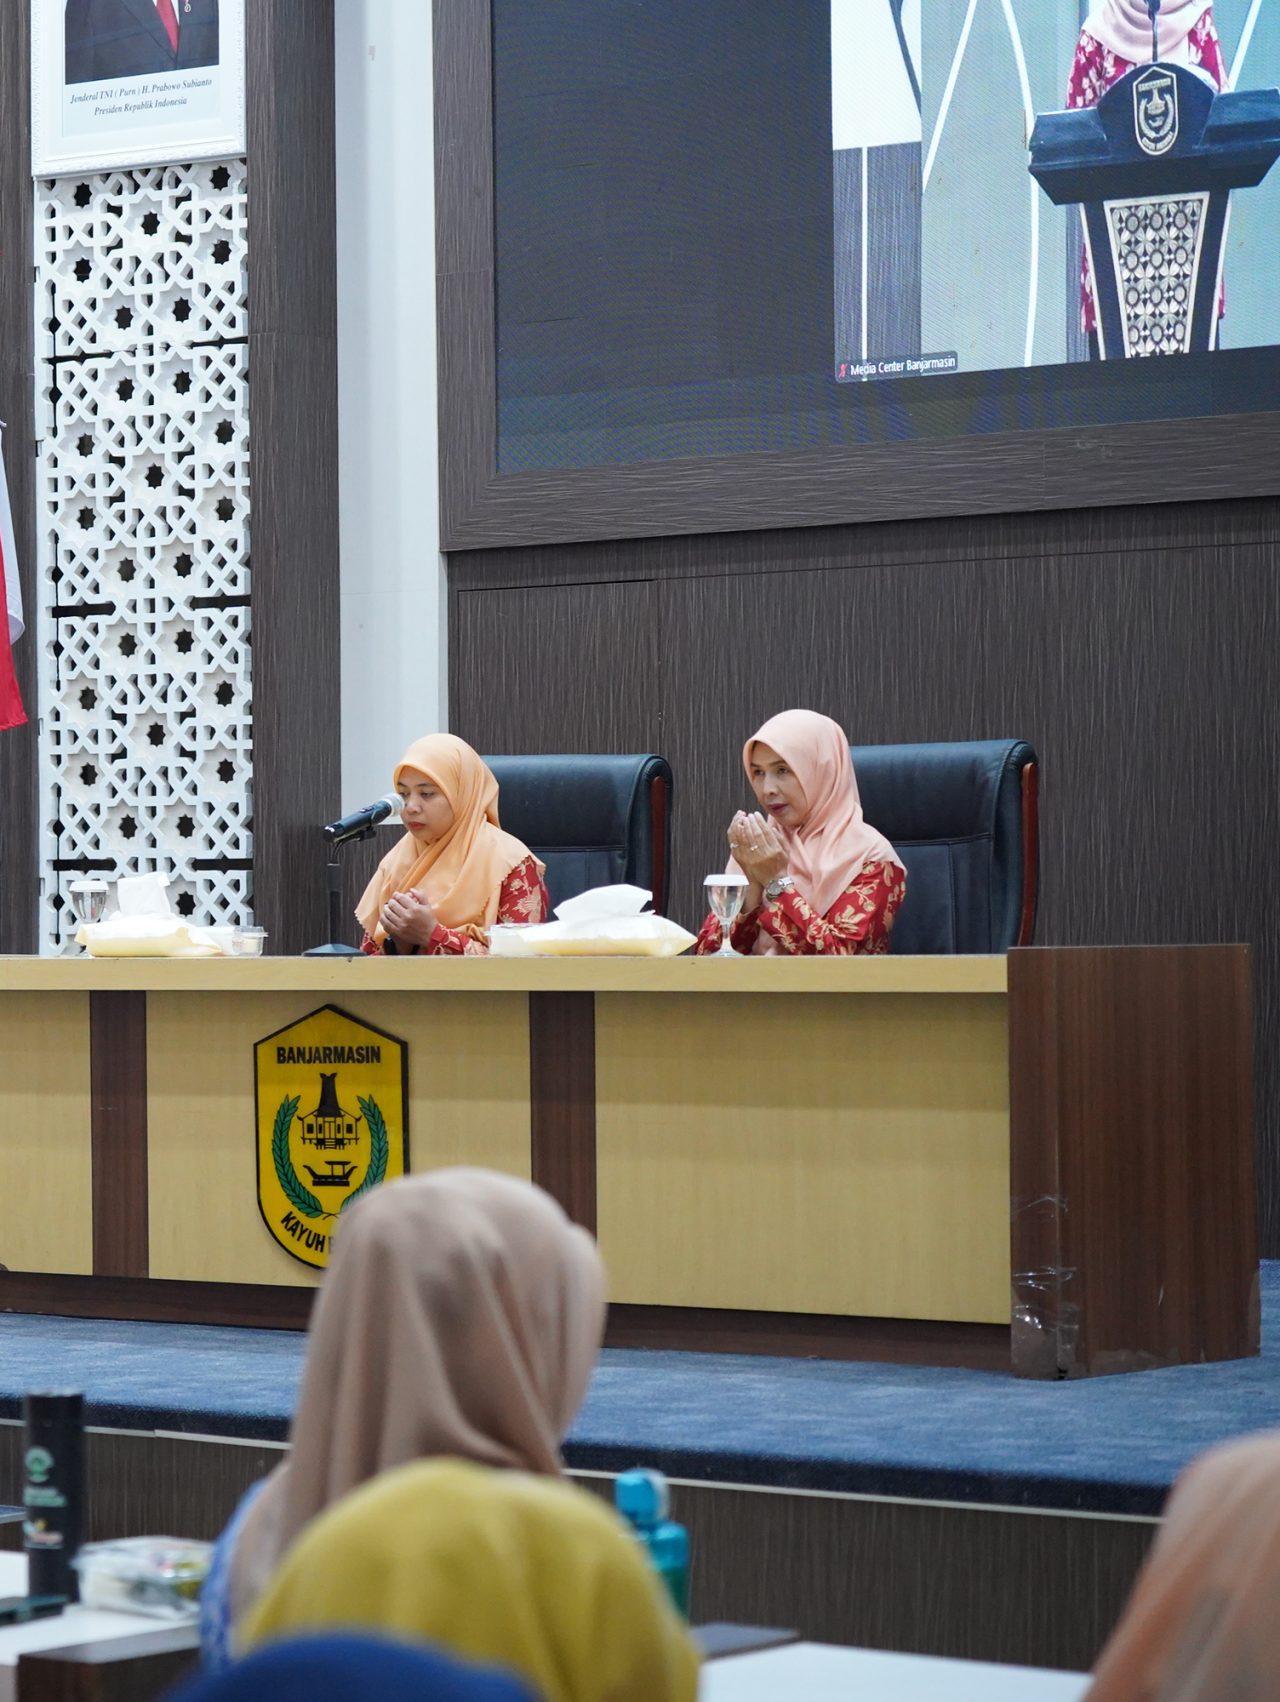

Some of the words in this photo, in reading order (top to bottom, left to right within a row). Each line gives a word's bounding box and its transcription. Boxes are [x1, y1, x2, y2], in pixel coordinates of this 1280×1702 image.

[70, 92, 98, 104] Jenderal
[100, 89, 113, 99] TNI
[119, 88, 136, 99] Purn
[142, 86, 150, 95] H.
[152, 82, 181, 94] Prabowo
[182, 78, 212, 89] Subianto
[94, 103, 122, 116] Presiden
[124, 100, 153, 113] Republik
[154, 96, 187, 108] Indonesia
[850, 363, 876, 376] Media
[878, 360, 904, 373] Center
[907, 356, 956, 372] Banjarmasin
[276, 1045, 381, 1064] BANJARMASIN
[281, 1211, 326, 1253] KAYUH
